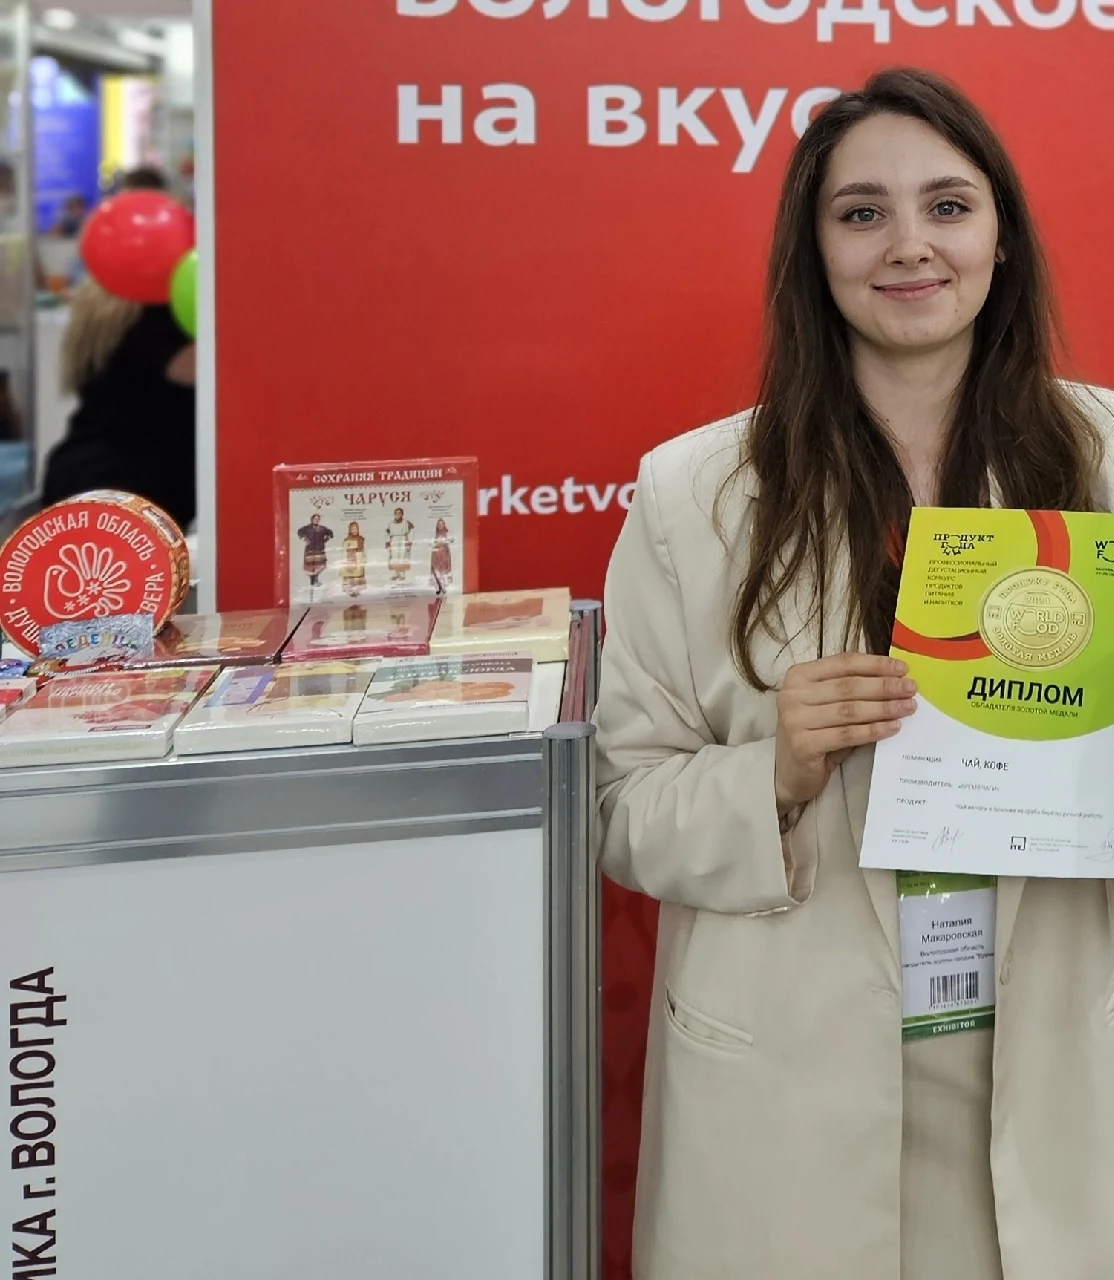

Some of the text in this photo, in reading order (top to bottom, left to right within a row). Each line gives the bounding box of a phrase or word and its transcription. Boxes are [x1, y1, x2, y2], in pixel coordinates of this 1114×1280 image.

[397, 82, 536, 146] на
[378, 468, 443, 482] ТРАДИЦИИ
[3, 511, 157, 593] ВОЛОГОДСКАЯ ОБЛАСТЬ
[967, 676, 1084, 708] ДИПЛОМ
[983, 760, 1009, 771] КОФЕ
[920, 929, 984, 945] Макаровская
[932, 1019, 976, 1034] EXHIBITOR
[9, 966, 68, 1170] ВОЛОГДА
[23, 1176, 56, 1199] г.
